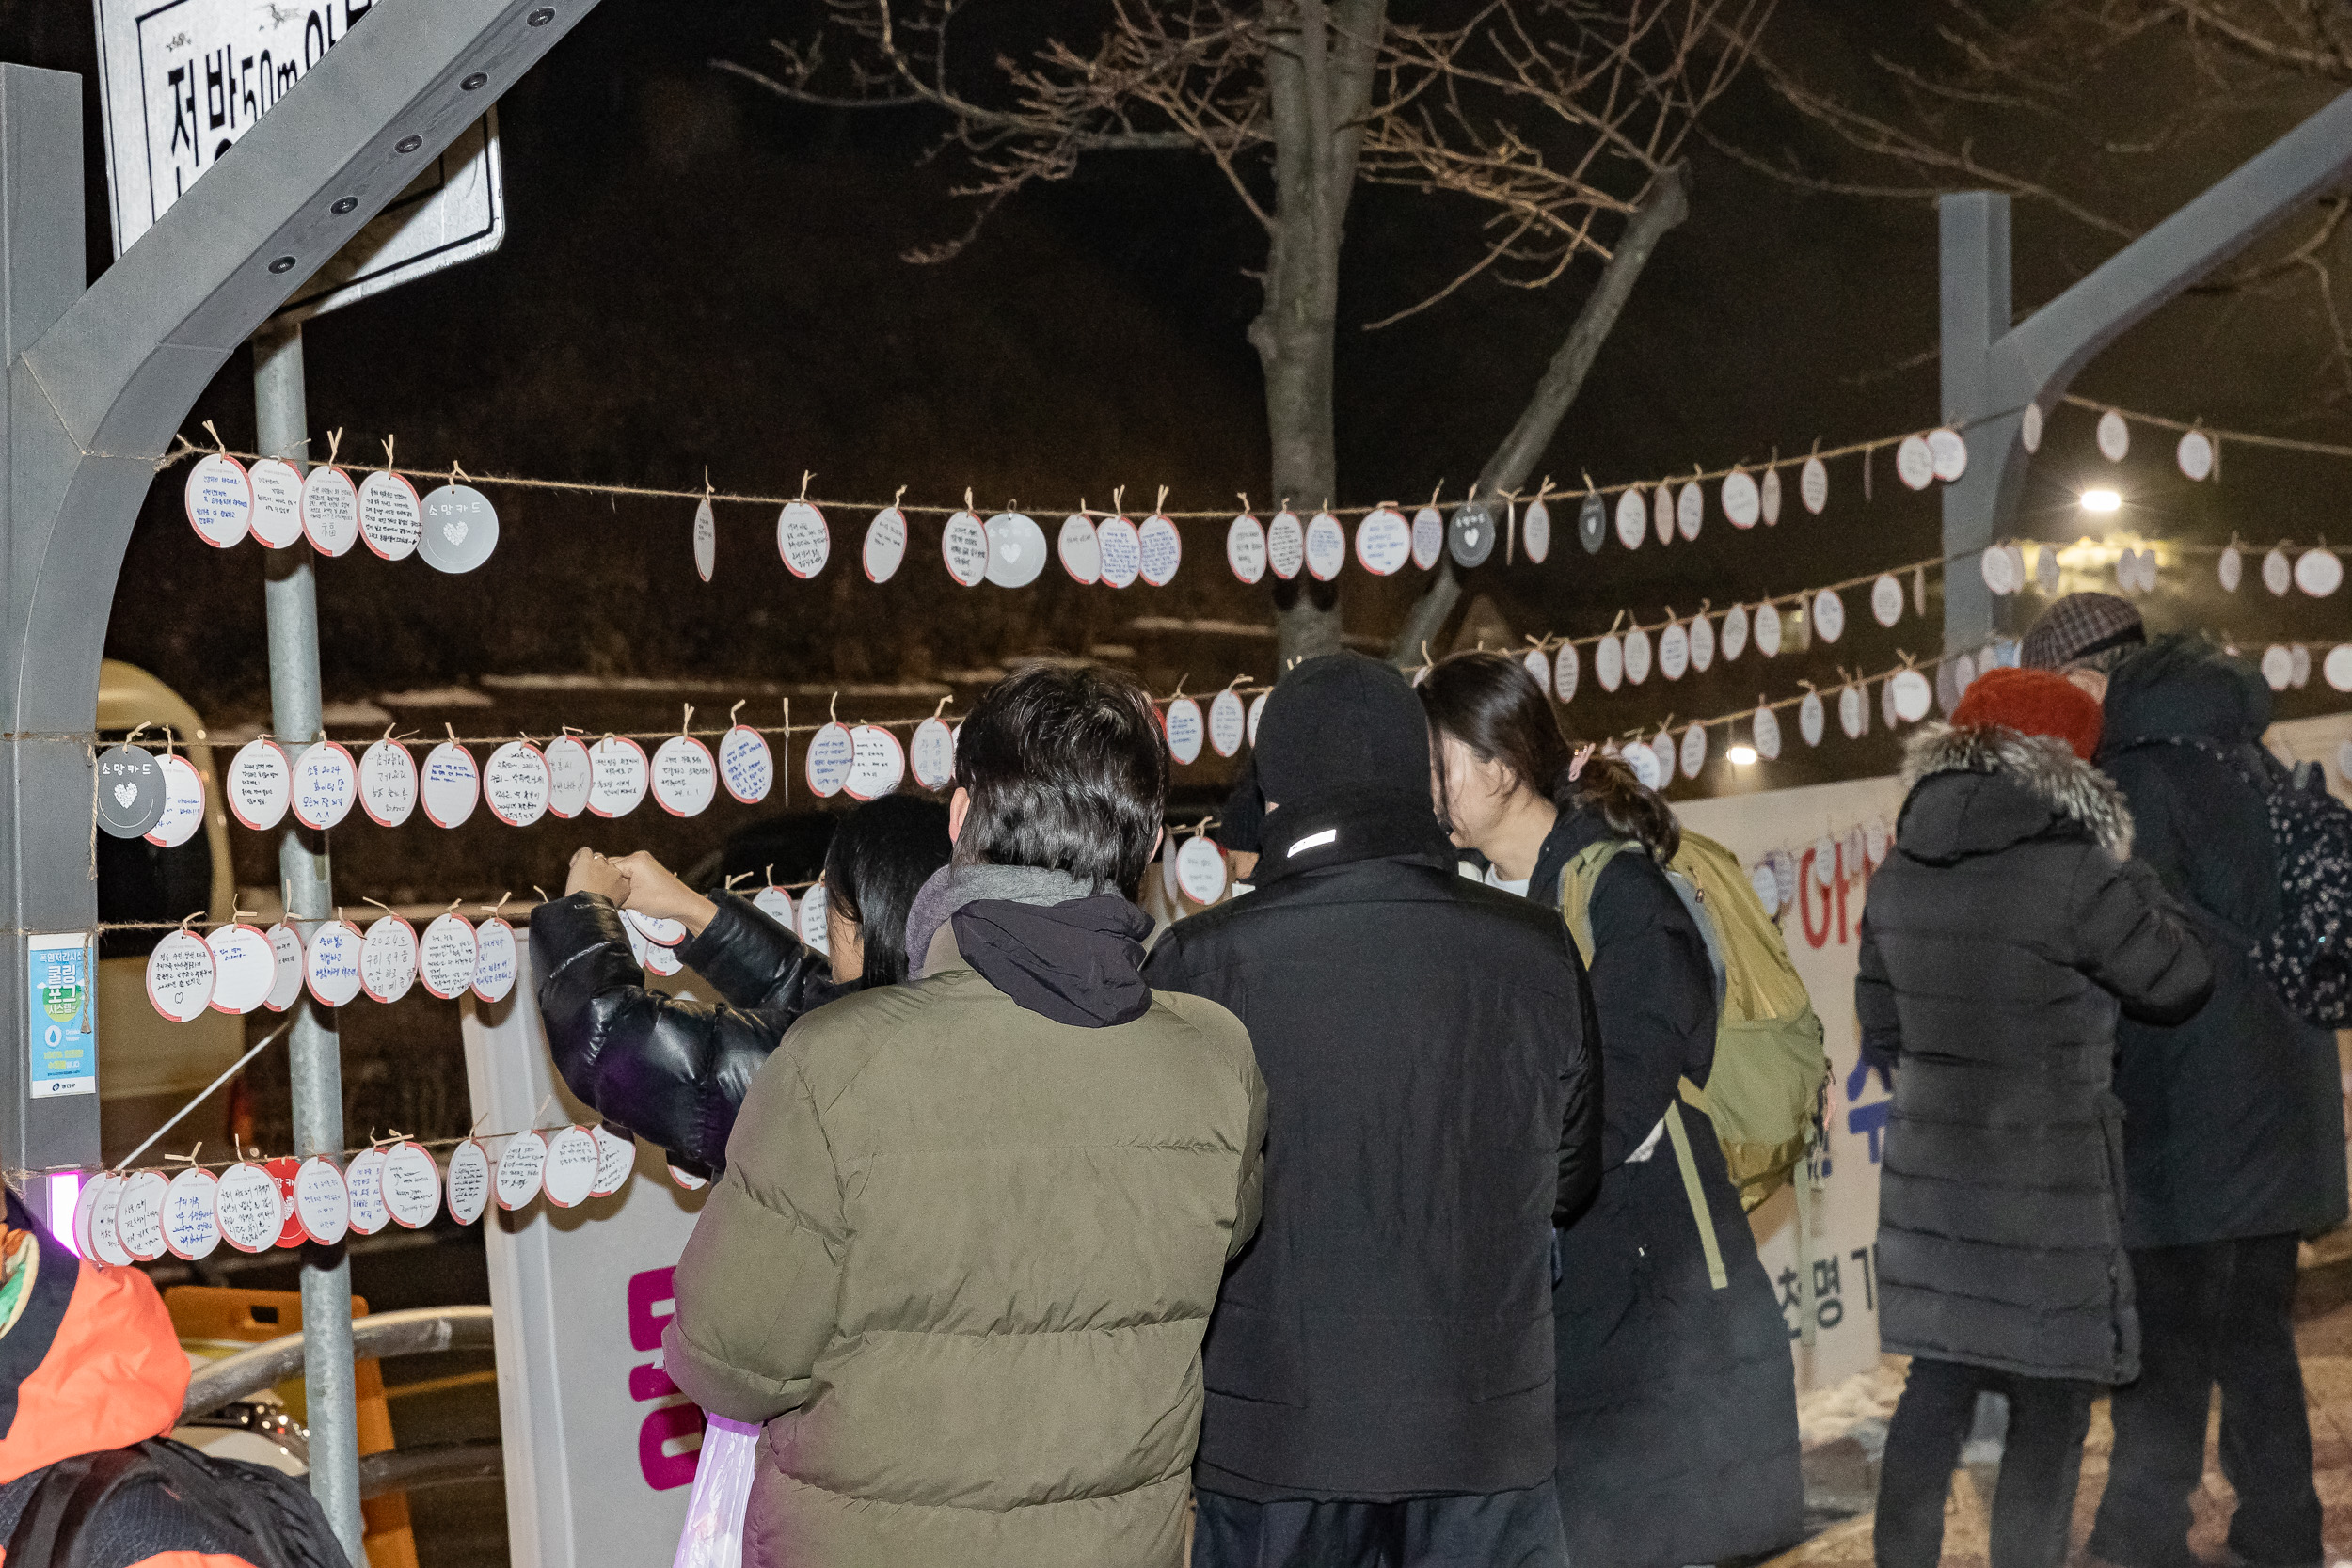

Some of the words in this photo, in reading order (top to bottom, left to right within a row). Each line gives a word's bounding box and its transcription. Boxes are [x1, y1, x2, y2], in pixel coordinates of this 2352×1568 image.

[428, 502, 482, 516] 소망카드
[102, 762, 151, 776] 소망카드
[321, 765, 341, 775] 2024
[48, 964, 76, 984] 쿨링
[48, 985, 76, 1003] 포그
